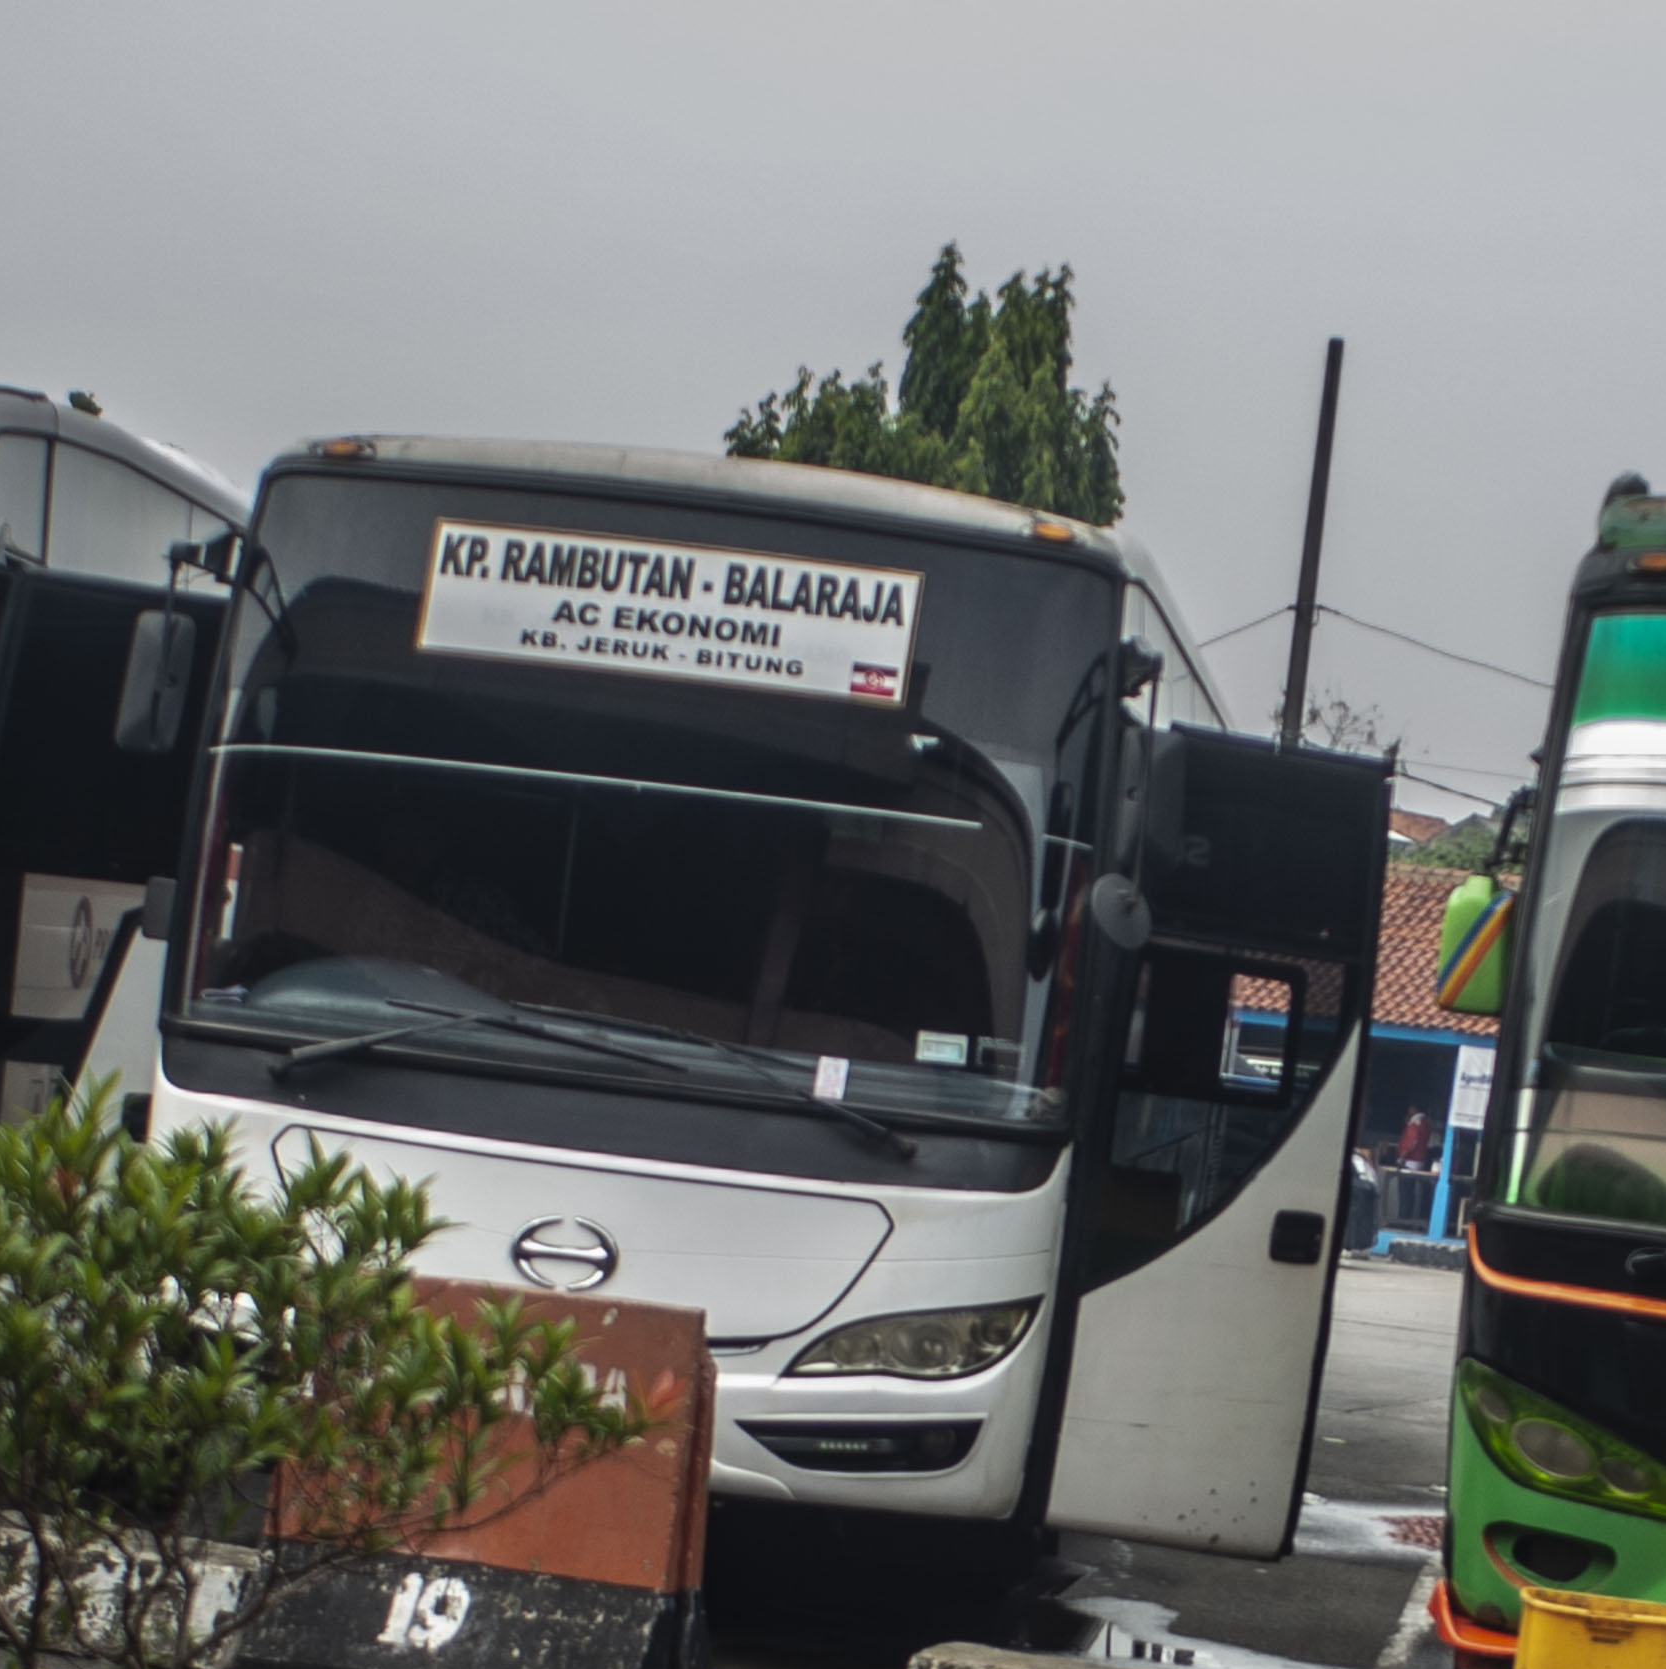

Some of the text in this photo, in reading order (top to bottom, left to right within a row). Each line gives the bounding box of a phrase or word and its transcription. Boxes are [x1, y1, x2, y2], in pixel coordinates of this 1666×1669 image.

[439, 534, 490, 578] KP.
[500, 539, 696, 599] RAMBUTAN
[722, 564, 905, 626] BALARAJA
[520, 629, 568, 651] KB.
[577, 635, 670, 661] JERUK
[696, 650, 805, 677] BITUNG
[552, 599, 782, 647] AC EKONOMI
[376, 1571, 472, 1652] 19
